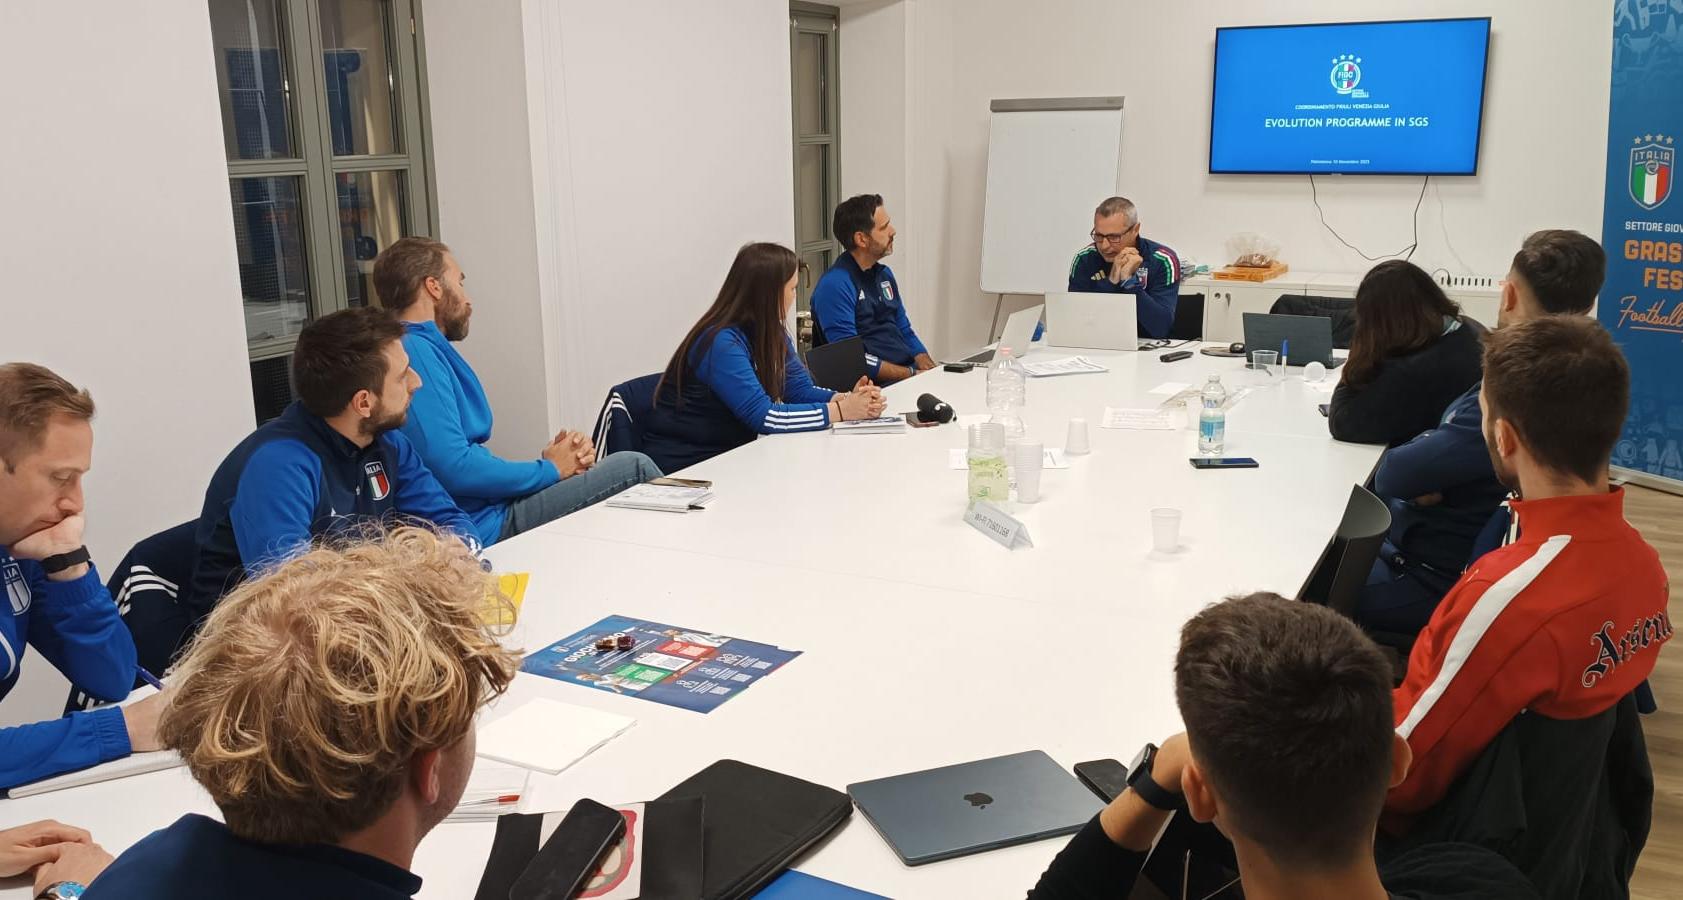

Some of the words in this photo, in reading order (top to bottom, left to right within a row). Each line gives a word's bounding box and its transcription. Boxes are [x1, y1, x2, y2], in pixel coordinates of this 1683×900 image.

[1265, 118, 1323, 128] EVOLUTION
[1326, 117, 1392, 128] PROGRAMME
[1394, 117, 1406, 127] IN
[1409, 117, 1429, 127] SGS
[1635, 151, 1670, 161] ITALIA
[1625, 221, 1663, 232] SETTORE
[1624, 239, 1682, 263] GRAS
[1644, 267, 1683, 290] FES
[1582, 612, 1673, 687] Arsen
